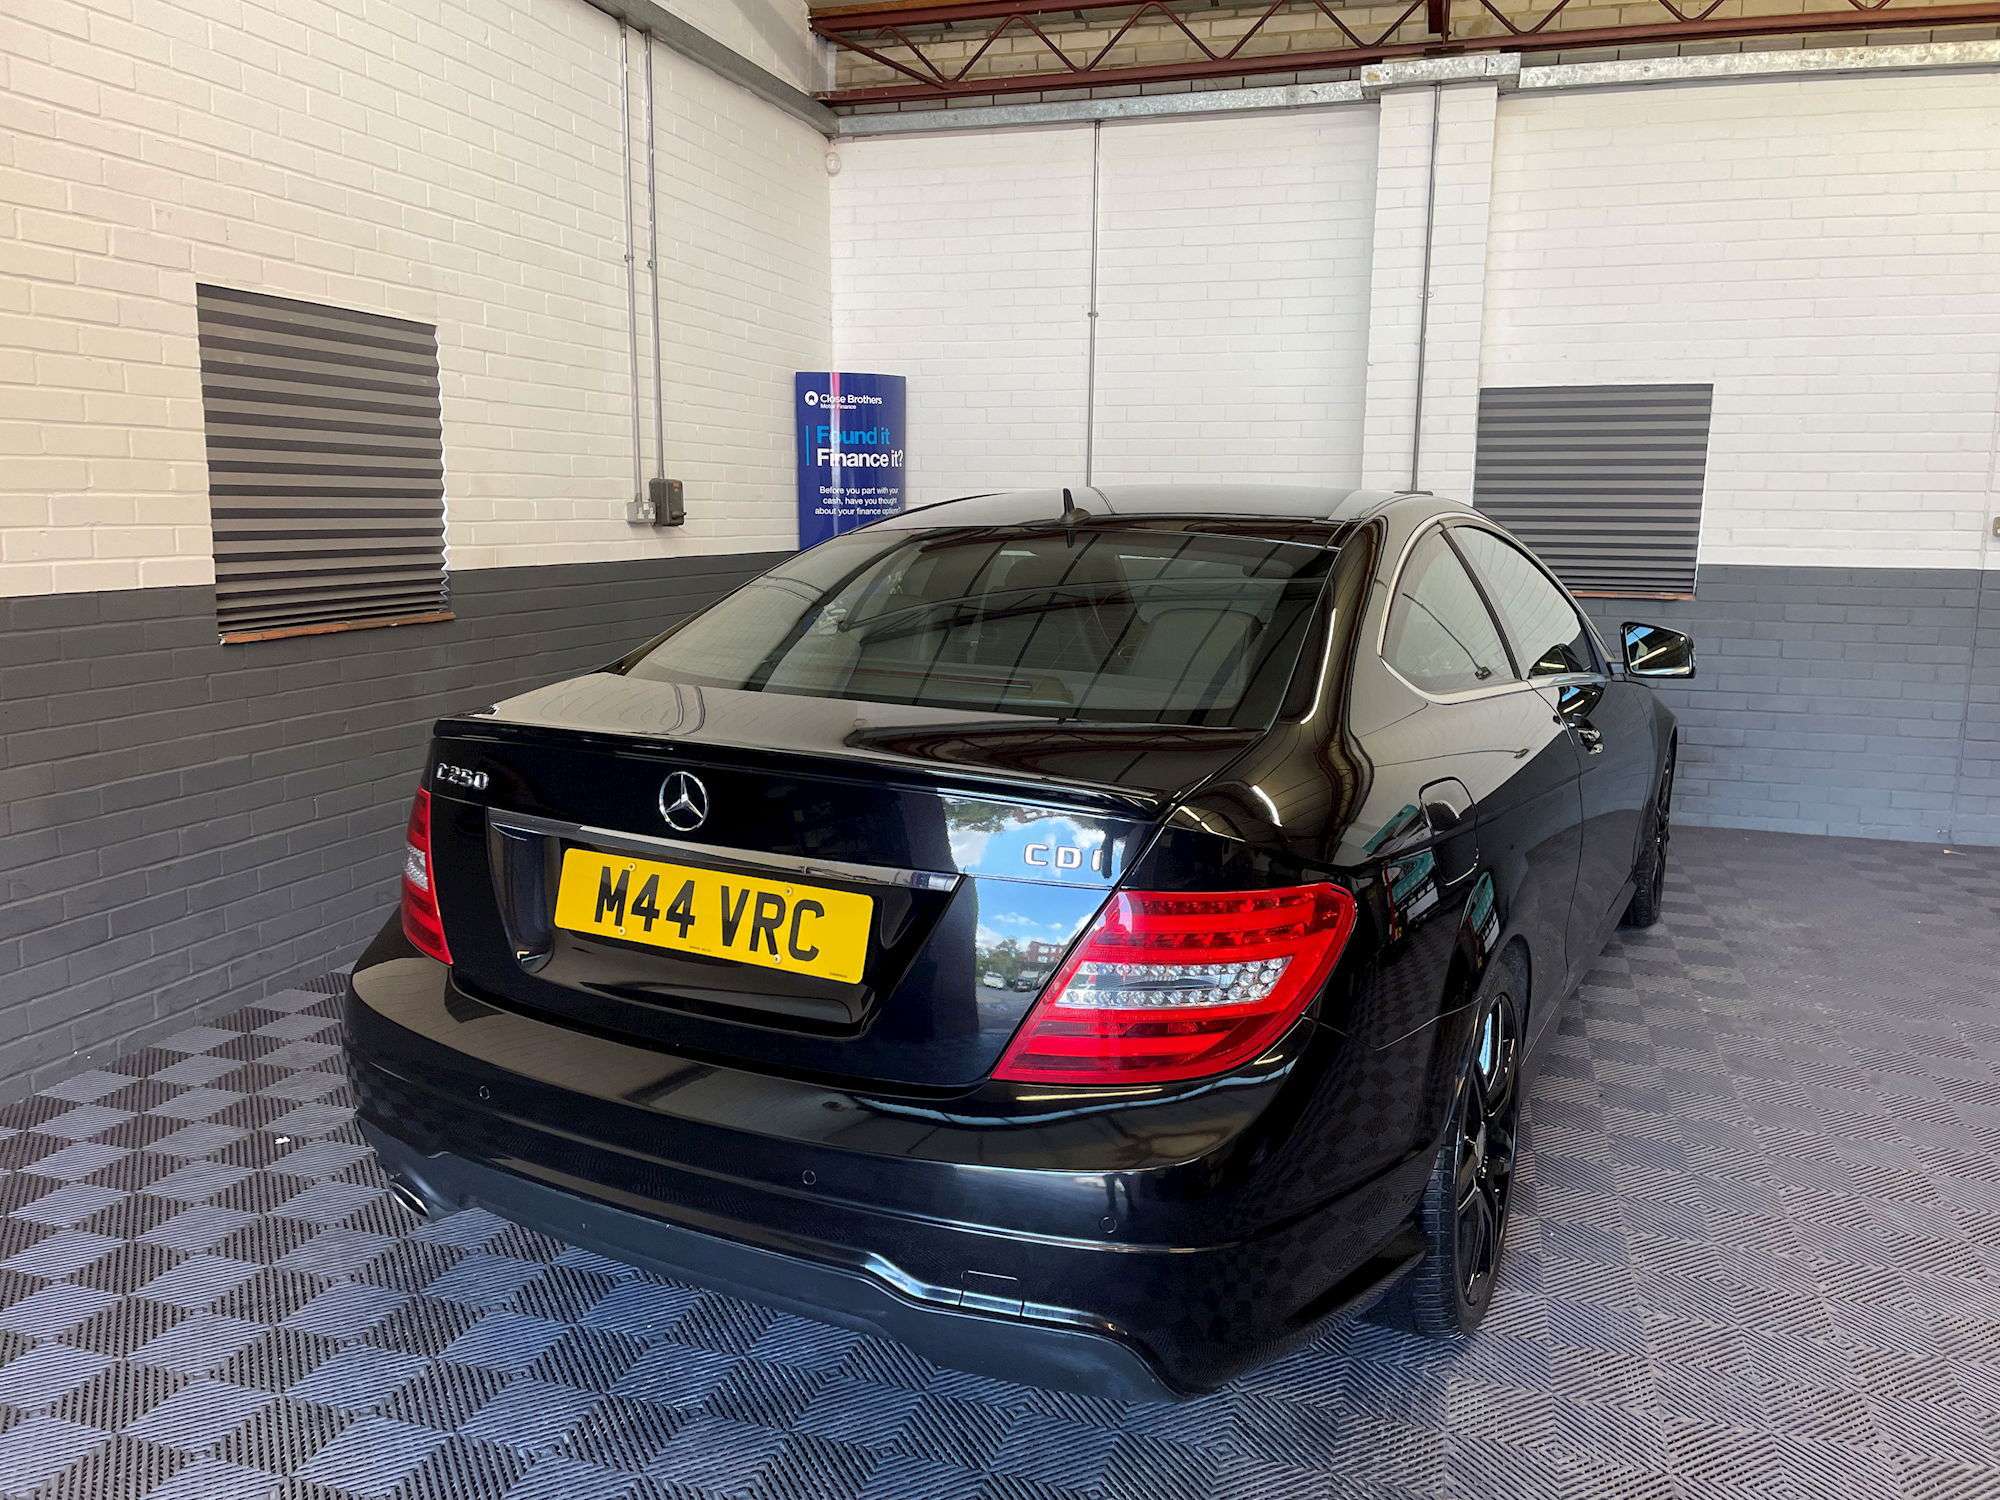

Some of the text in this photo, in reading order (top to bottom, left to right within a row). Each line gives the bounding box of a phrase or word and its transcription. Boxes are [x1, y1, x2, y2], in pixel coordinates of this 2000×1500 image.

[820, 393, 883, 405] Close Brothers
[881, 427, 890, 445] it
[817, 448, 904, 468] Finance it?
[819, 486, 845, 495] Before
[846, 487, 861, 497] you
[861, 487, 876, 496] part
[876, 487, 889, 495] with
[845, 498, 864, 506] have
[864, 499, 878, 507] you
[815, 507, 837, 516] about
[838, 508, 855, 517] your
[856, 508, 881, 516] finance
[436, 762, 490, 791] C250
[1024, 842, 1104, 873] CDI
[594, 865, 826, 963] M44 VRC
